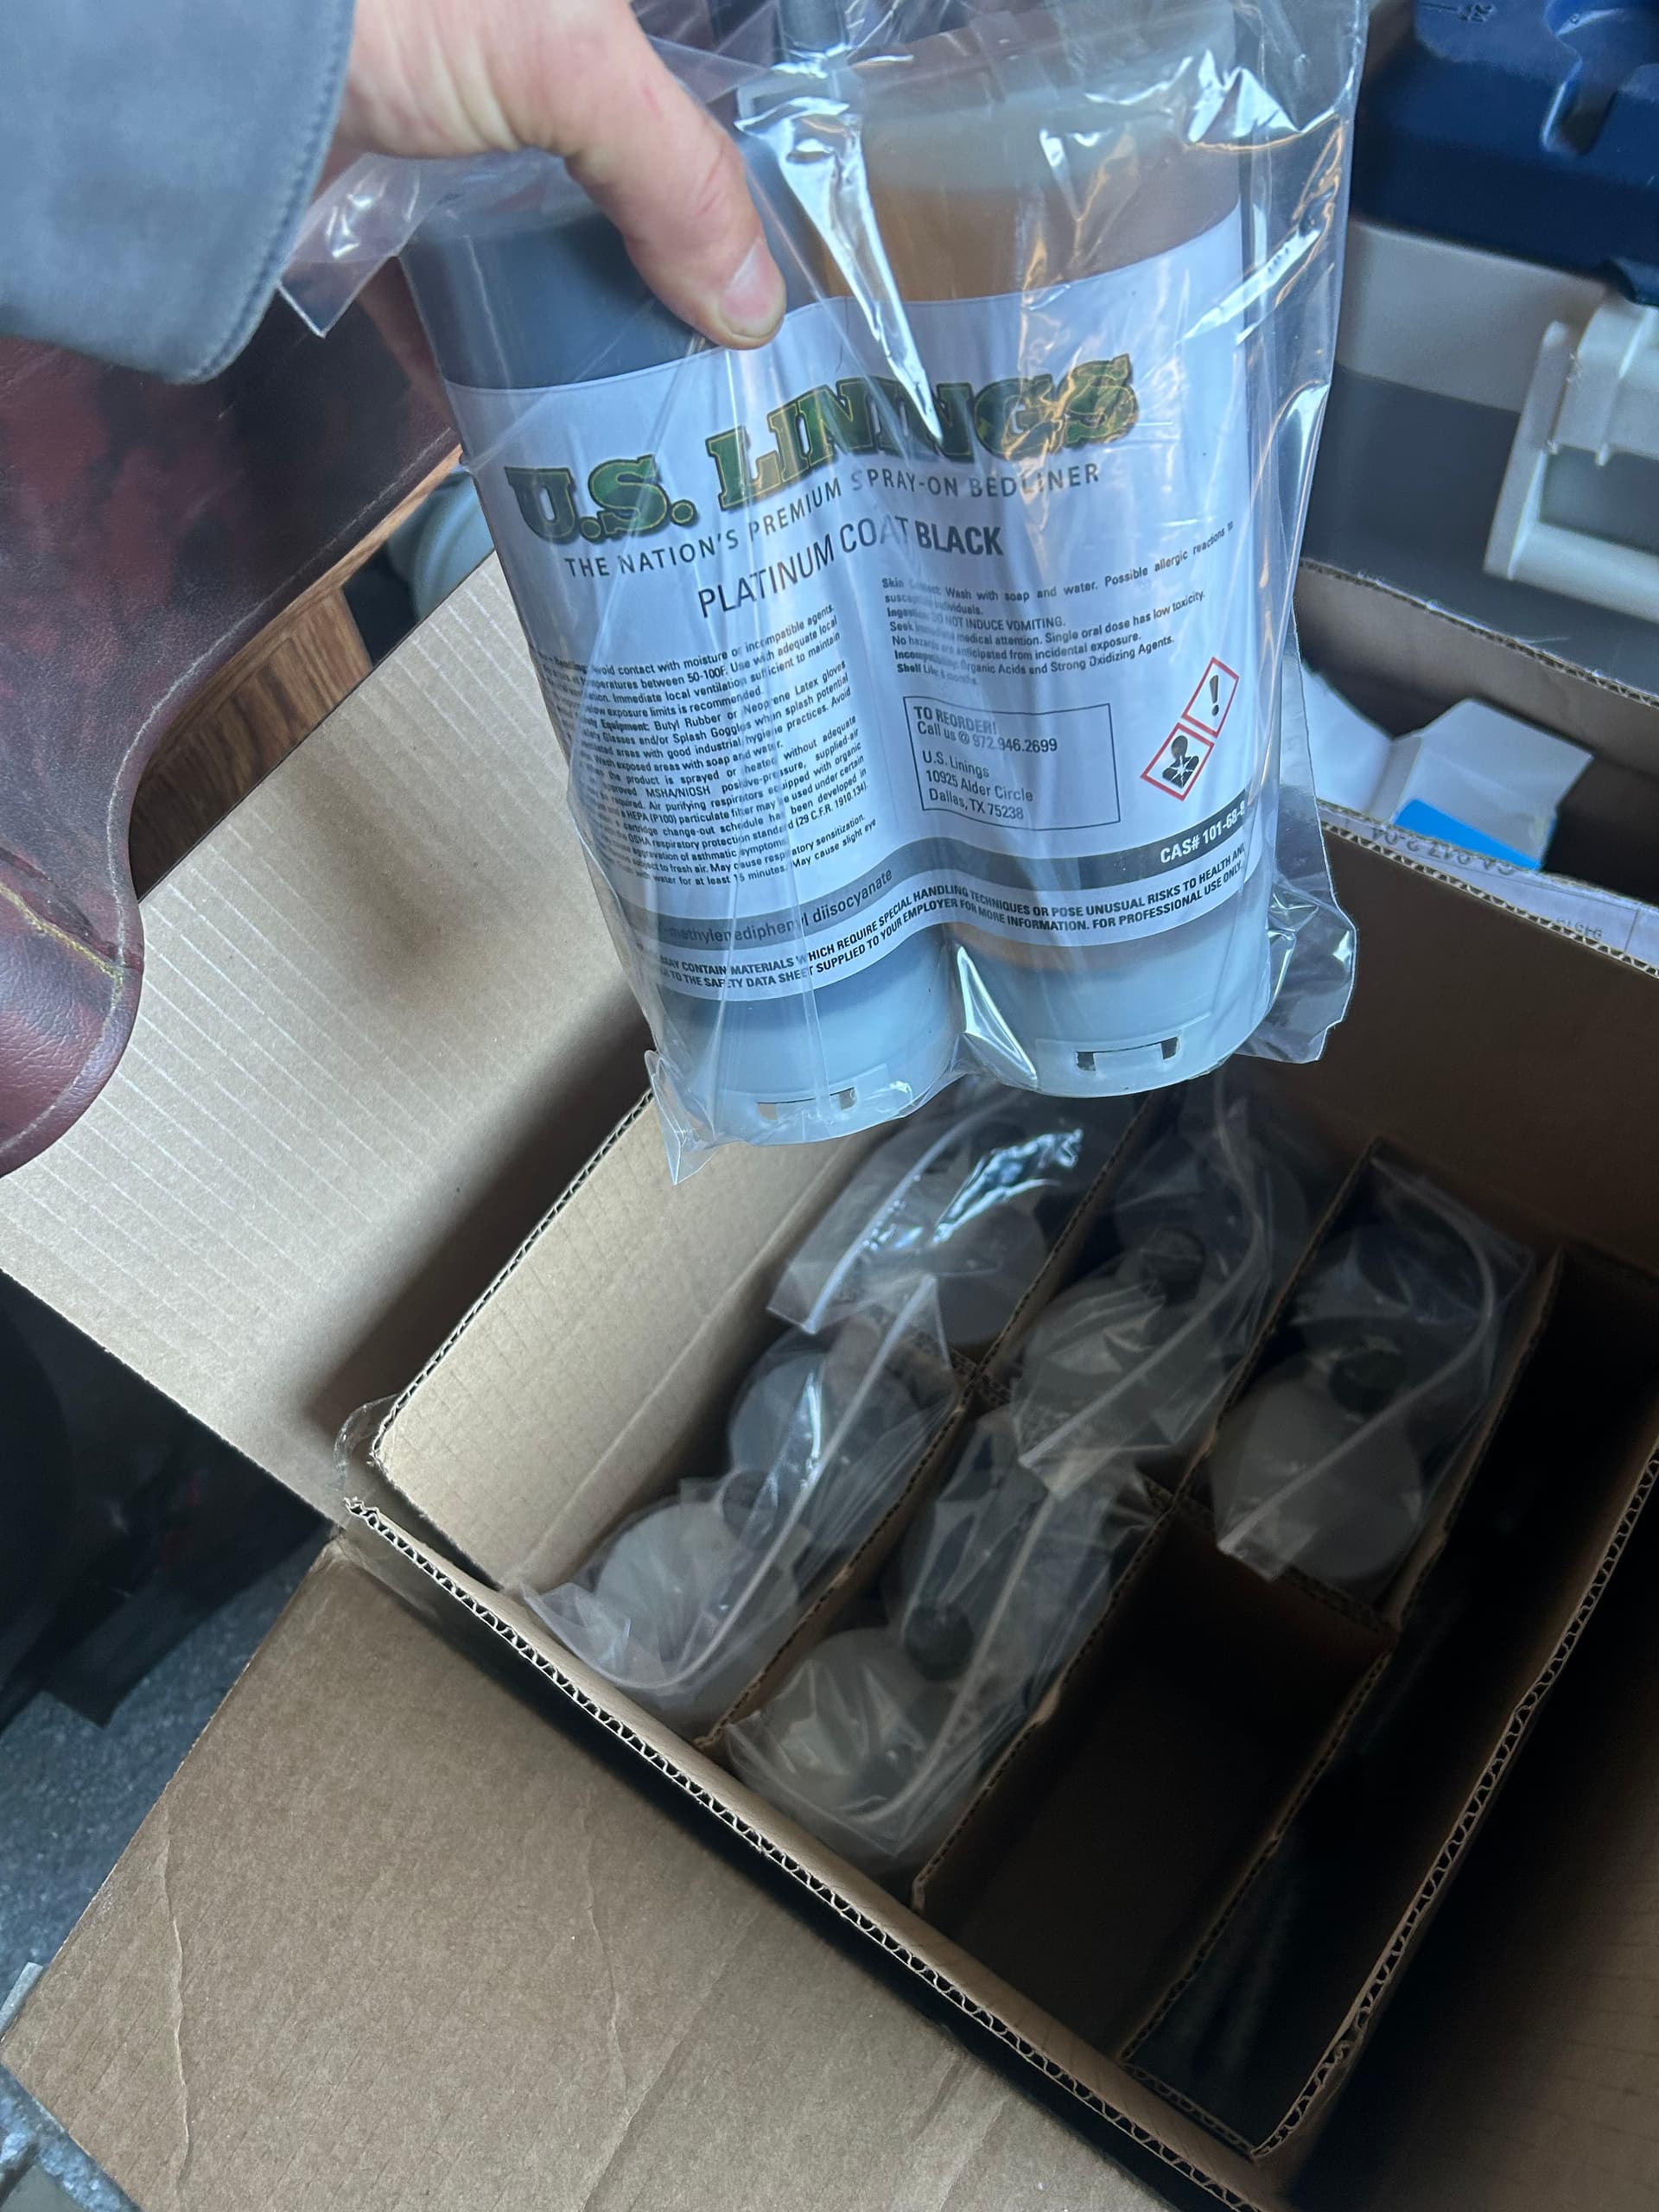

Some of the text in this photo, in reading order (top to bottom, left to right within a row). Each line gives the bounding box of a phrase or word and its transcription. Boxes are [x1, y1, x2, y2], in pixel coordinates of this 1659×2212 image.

[504, 353, 1139, 544] U.S. LININGS
[564, 462, 1100, 579] THE NATION'S PREMIUM SPRAY-ON BEDLINER
[697, 516, 1004, 619] PLATINUM COAT BLACK
[945, 587, 971, 600] Wash
[976, 590, 999, 601] with
[1005, 591, 1030, 603] soap
[1037, 586, 1057, 599] and
[1063, 582, 1098, 595] water.
[1104, 566, 1148, 587] Possible
[1154, 550, 1188, 572] allergic
[1192, 528, 1225, 556] reactions
[892, 635, 906, 645] No
[1009, 649, 1033, 660] from
[1035, 643, 1088, 660] incidental
[1090, 632, 1141, 654] exposure.
[965, 616, 1066, 632] INDUCE VOMITING.
[995, 589, 1205, 646] attention. Single oral dose has low toxicity.
[613, 692, 662, 704] Immediate
[664, 689, 690, 702] local
[796, 652, 805, 664] to
[808, 631, 841, 658] maintain
[618, 650, 728, 675] contact with moisture
[640, 615, 837, 689] between Use adequate local
[998, 633, 1174, 674] Acids and Strong Oxidizing Agents.
[607, 703, 687, 719] exposure limits is
[616, 689, 851, 760] areas with good industrial practices. Avoid
[639, 673, 849, 745] and/or Splash Goggles splash potential
[654, 659, 846, 731] Butyl Rubber or Latex gloves
[914, 705, 997, 734] TO REORDER!
[626, 715, 856, 787] product is sprayed or without adequate
[645, 727, 859, 798] MSHA/NIOSH supplied-air
[654, 753, 730, 772] areas with soap
[918, 721, 1058, 753] Call us @ 972.946.2699
[922, 750, 989, 779] U.S. Linings
[626, 754, 864, 825] HEPA (P100) particulate may used under certain
[649, 741, 861, 814] Air purifying respirators with organic
[663, 766, 867, 837] change-out been developed in
[925, 769, 1033, 802] 10925 Alder Circle
[929, 787, 1024, 820] Dallas, TX 75238
[652, 836, 699, 849] respiratory
[671, 813, 866, 874] fresh air. May cause sensitization.
[679, 818, 877, 886] for at least cause slight eye
[680, 849, 736, 862] of asthmatic
[1160, 800, 1245, 864] CAS# 101-68-8
[682, 960, 727, 976] CONTAIN
[730, 957, 795, 976] MATERIALS
[836, 920, 878, 951] REQUIRE
[878, 896, 912, 927] SPECIAL
[912, 884, 969, 902] HANDLING
[969, 889, 1031, 916] TECHNIQUES
[1033, 905, 1049, 917] OR
[1052, 906, 1084, 918] POSE
[1086, 897, 1145, 916] UNUSUAL
[1147, 884, 1180, 906] RISKS
[1182, 877, 1197, 892] TO
[1198, 855, 1232, 885] HEALTH
[683, 861, 1243, 988] THE DATA SUPPLIED TO YOUR EMPLOYER FOR MORE INFORMATION. FOR PROFESSIONAL USE ONLY.
[812, 868, 893, 924] diisocyanate
